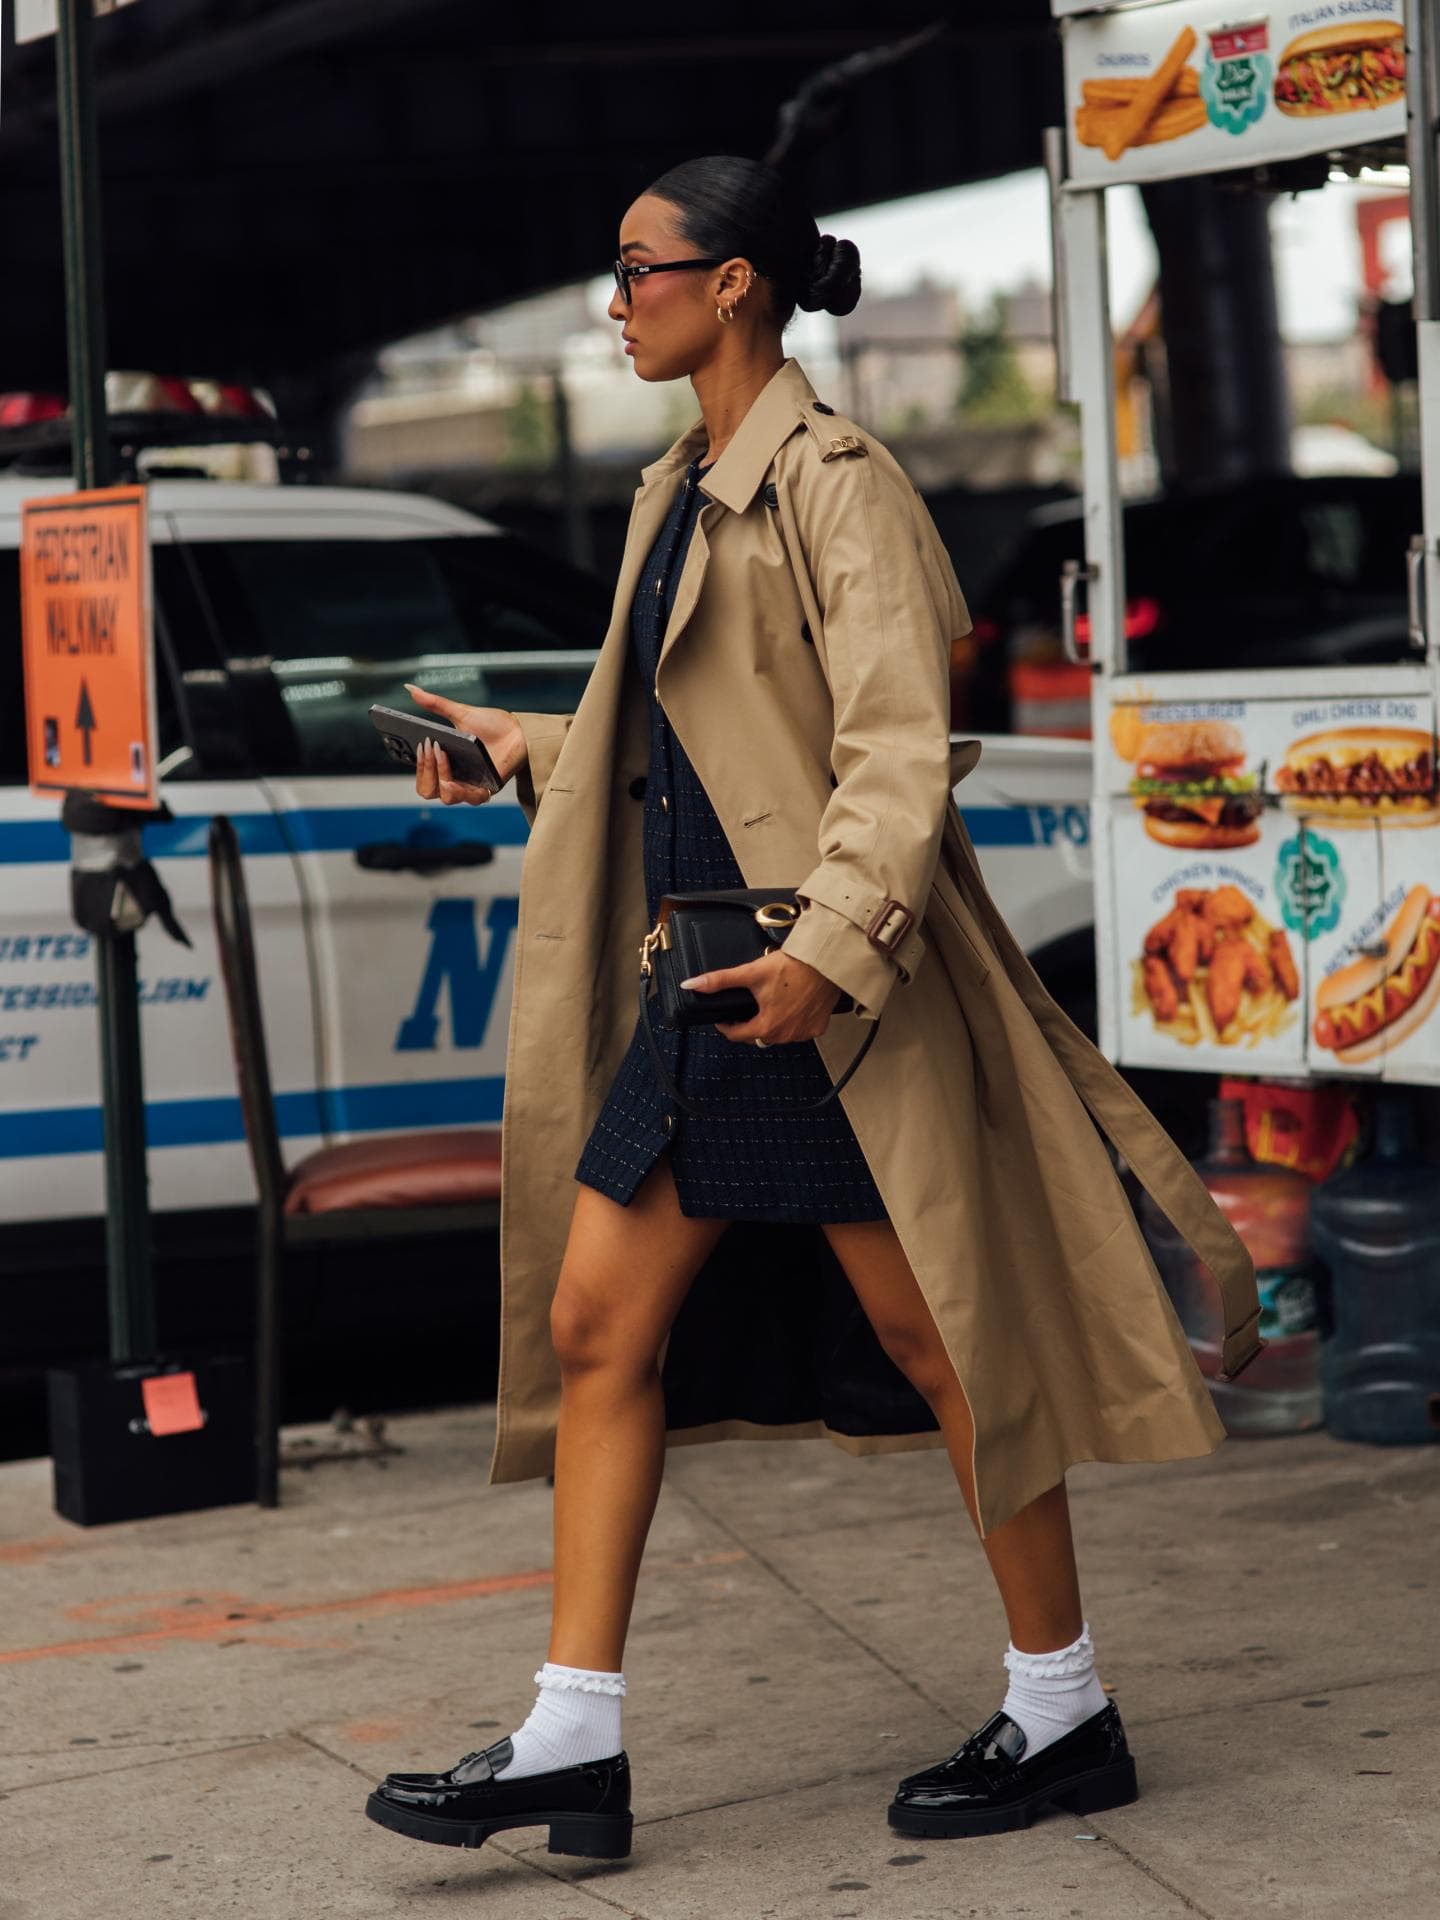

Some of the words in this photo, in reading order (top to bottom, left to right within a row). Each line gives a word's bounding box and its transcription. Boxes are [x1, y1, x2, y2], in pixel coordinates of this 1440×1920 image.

[34, 522, 130, 584] PEDESTRIAN
[45, 596, 119, 657] WALKWAY
[1139, 702, 1247, 724] CHEESEBURGER
[1293, 709, 1327, 728] CHILI
[1331, 701, 1381, 720] CHEESE
[1386, 701, 1417, 721] DOG
[1151, 862, 1212, 903] CHICKEN
[1216, 864, 1265, 902] WINGS
